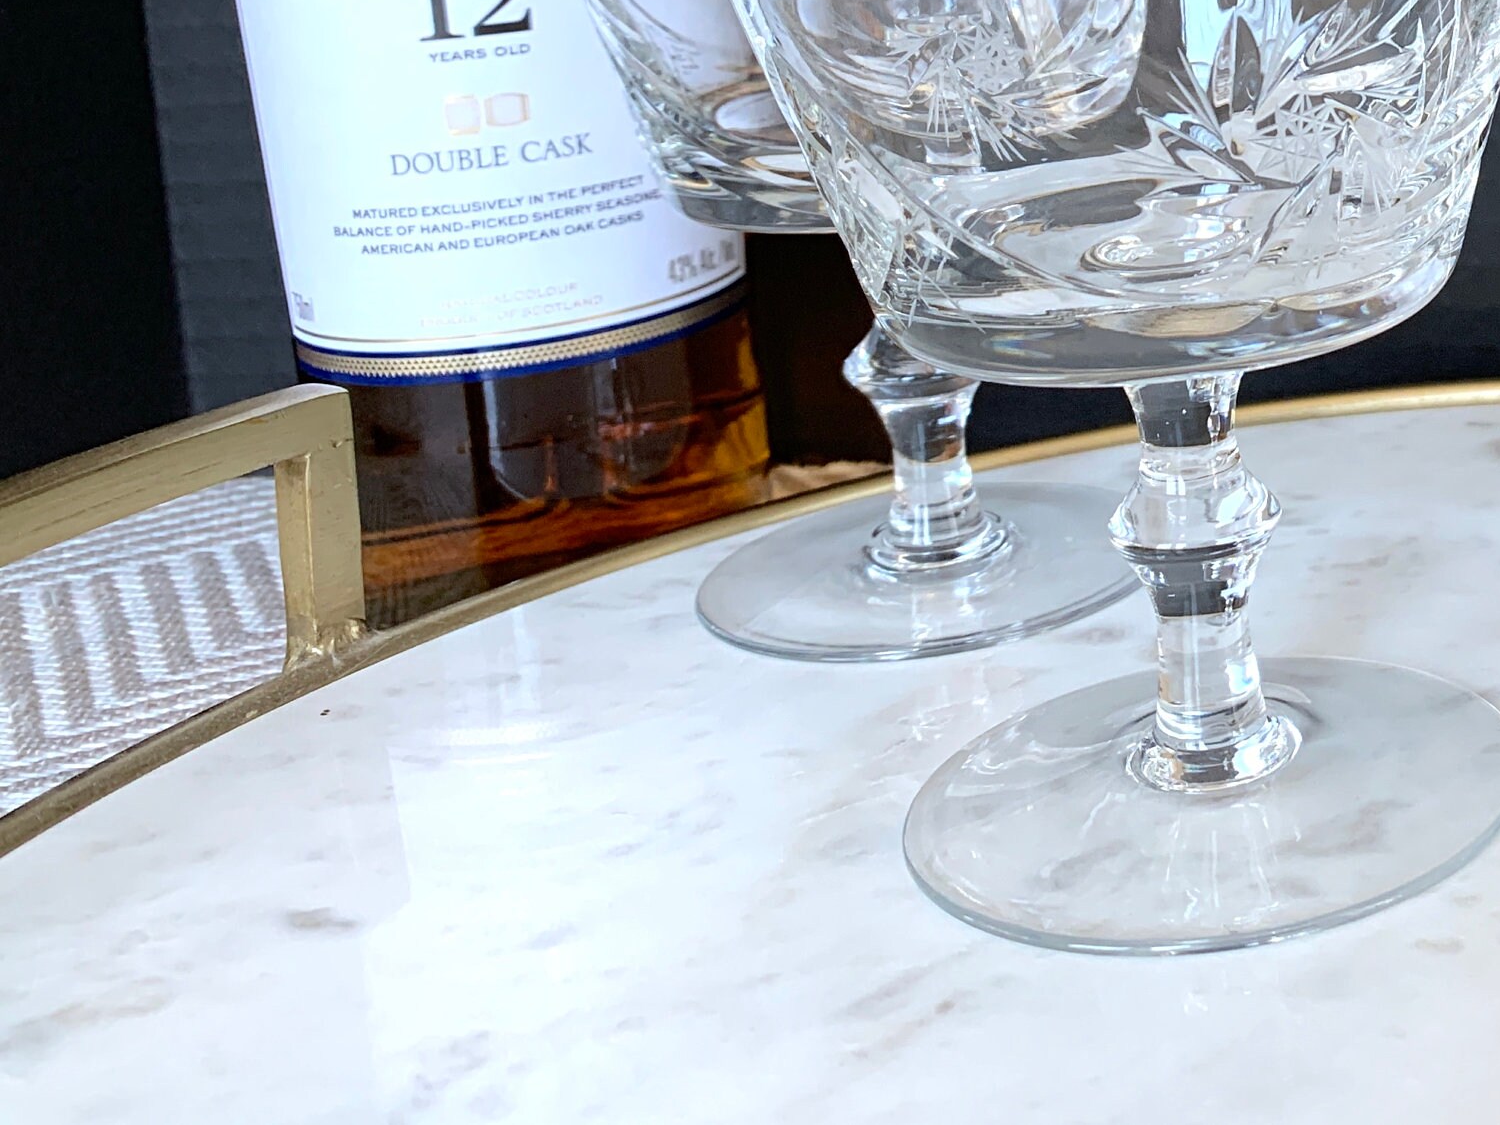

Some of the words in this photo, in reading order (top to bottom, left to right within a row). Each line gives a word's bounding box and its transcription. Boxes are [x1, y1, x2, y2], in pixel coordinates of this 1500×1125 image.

[428, 47, 487, 63] YEARS
[494, 42, 532, 57] OLD
[390, 145, 508, 177] DOUBLE
[520, 132, 593, 163] CASK
[333, 225, 393, 237] BALANCE
[396, 224, 416, 236] OF
[420, 213, 529, 234] HAND-PICKED
[531, 203, 594, 223] SHERRY
[596, 188, 663, 212] SEASONE
[351, 206, 418, 220] MATURED
[421, 196, 524, 217] EXCLUSIVELY
[528, 192, 545, 205] IN
[547, 188, 577, 202] THE
[580, 174, 644, 196] PERFECT
[361, 242, 434, 255] AMERICAN
[437, 238, 470, 252] AND
[473, 227, 560, 249] EUROPEAN
[563, 220, 595, 236] OAK
[597, 210, 644, 230] CASKS
